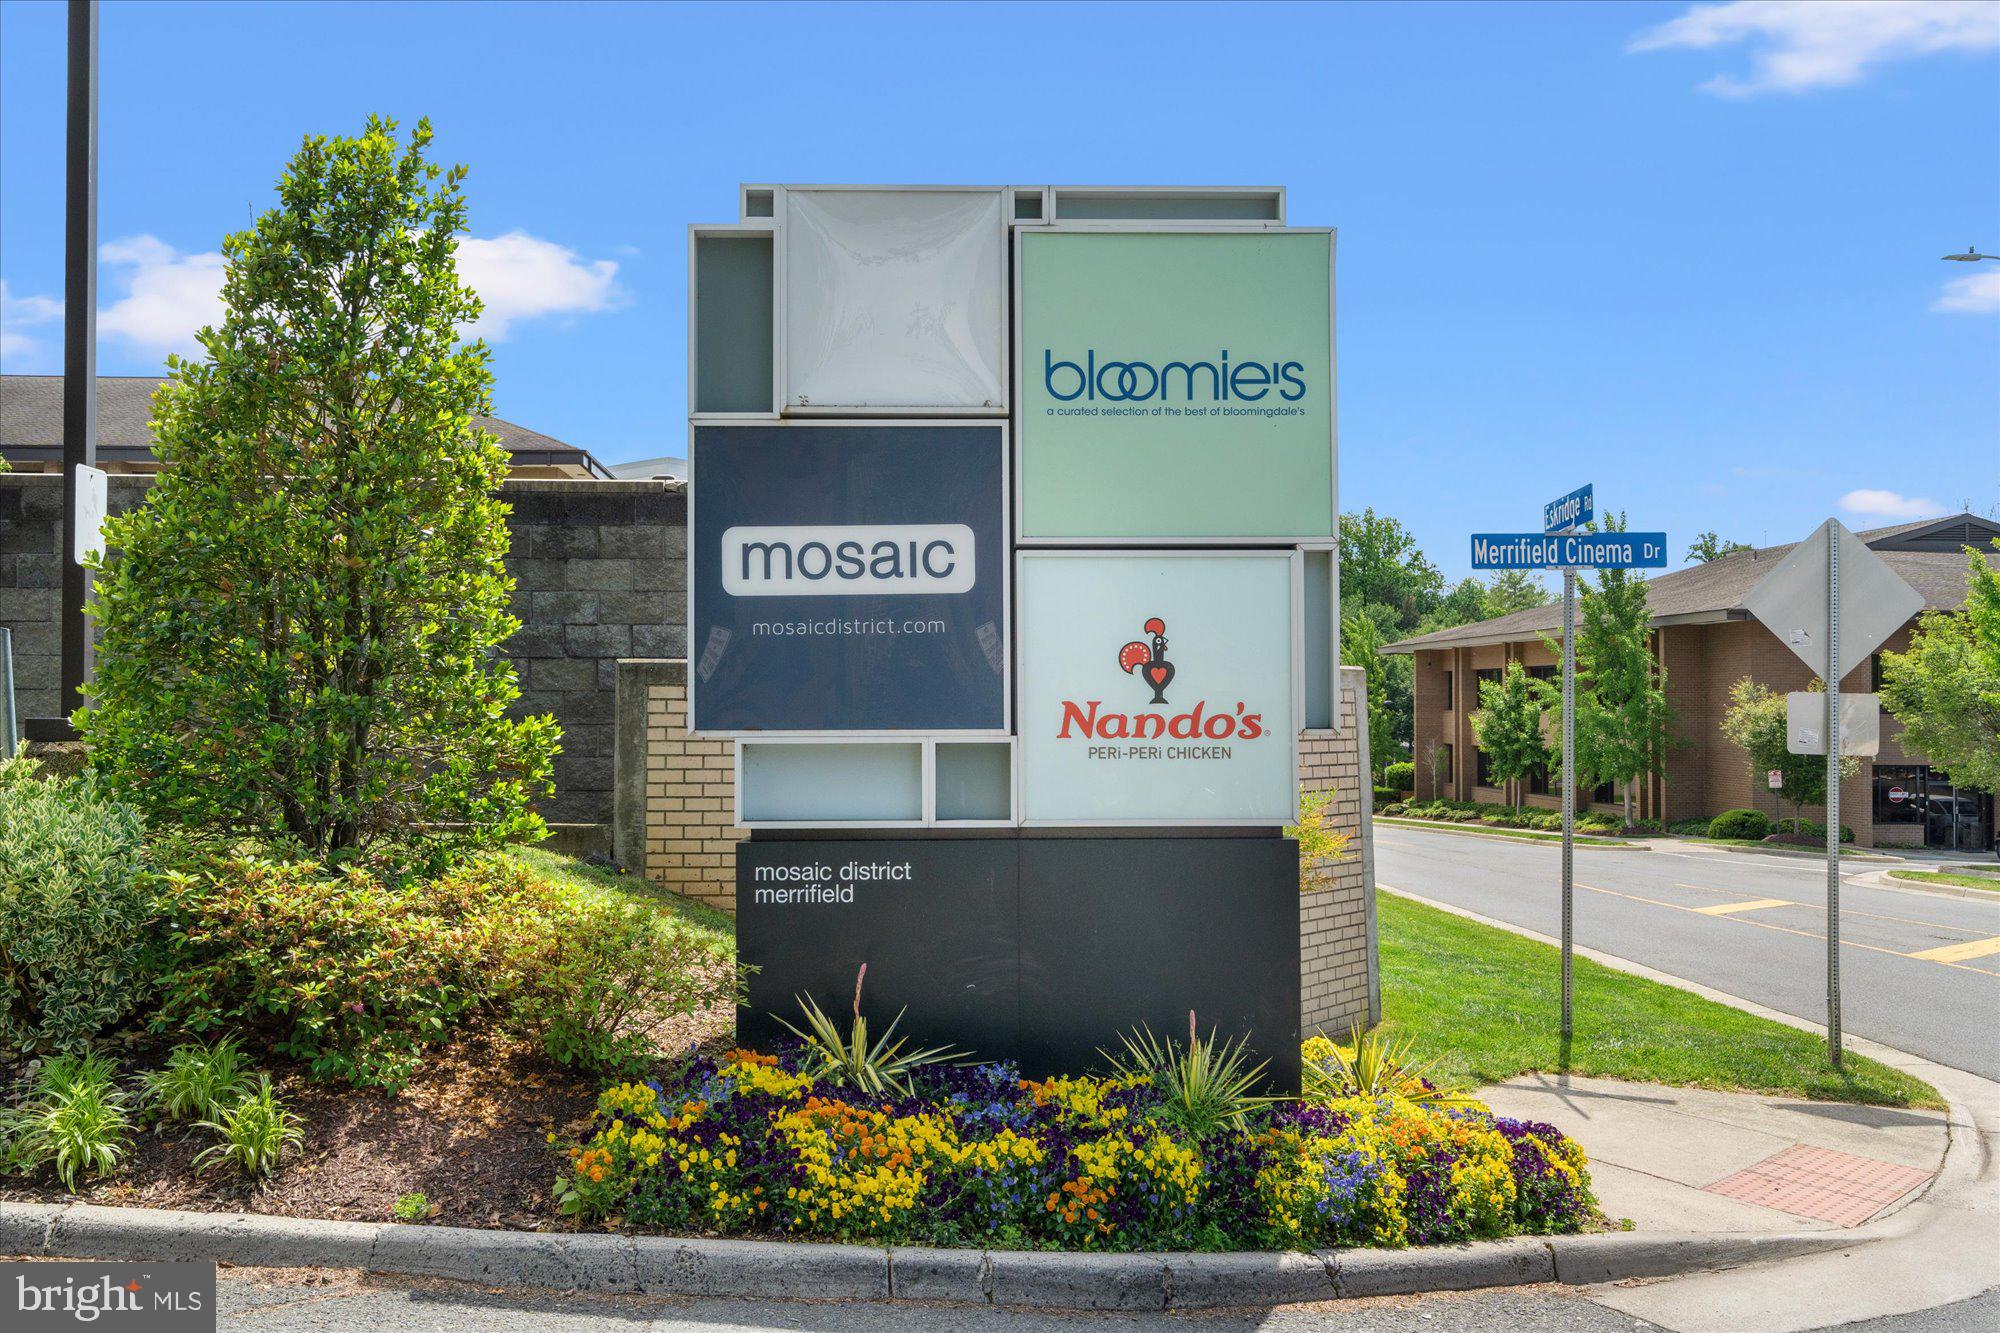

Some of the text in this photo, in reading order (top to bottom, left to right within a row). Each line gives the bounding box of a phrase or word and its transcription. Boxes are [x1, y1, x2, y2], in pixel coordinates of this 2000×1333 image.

[1045, 349, 1306, 401] bloomie's
[1046, 407, 1305, 418] a curated selection of the best of bloomingdale's
[1545, 494, 1593, 530] Eskridge Rd
[742, 540, 955, 580] mosaic
[1474, 538, 1661, 564] Merrifield Cinema Dr
[753, 618, 946, 635] mosaicdistrict.com
[1056, 700, 1262, 739] Nando's
[1167, 746, 1232, 760] CHICKEN
[755, 861, 912, 881] mosaic district
[755, 884, 854, 903] merrifield
